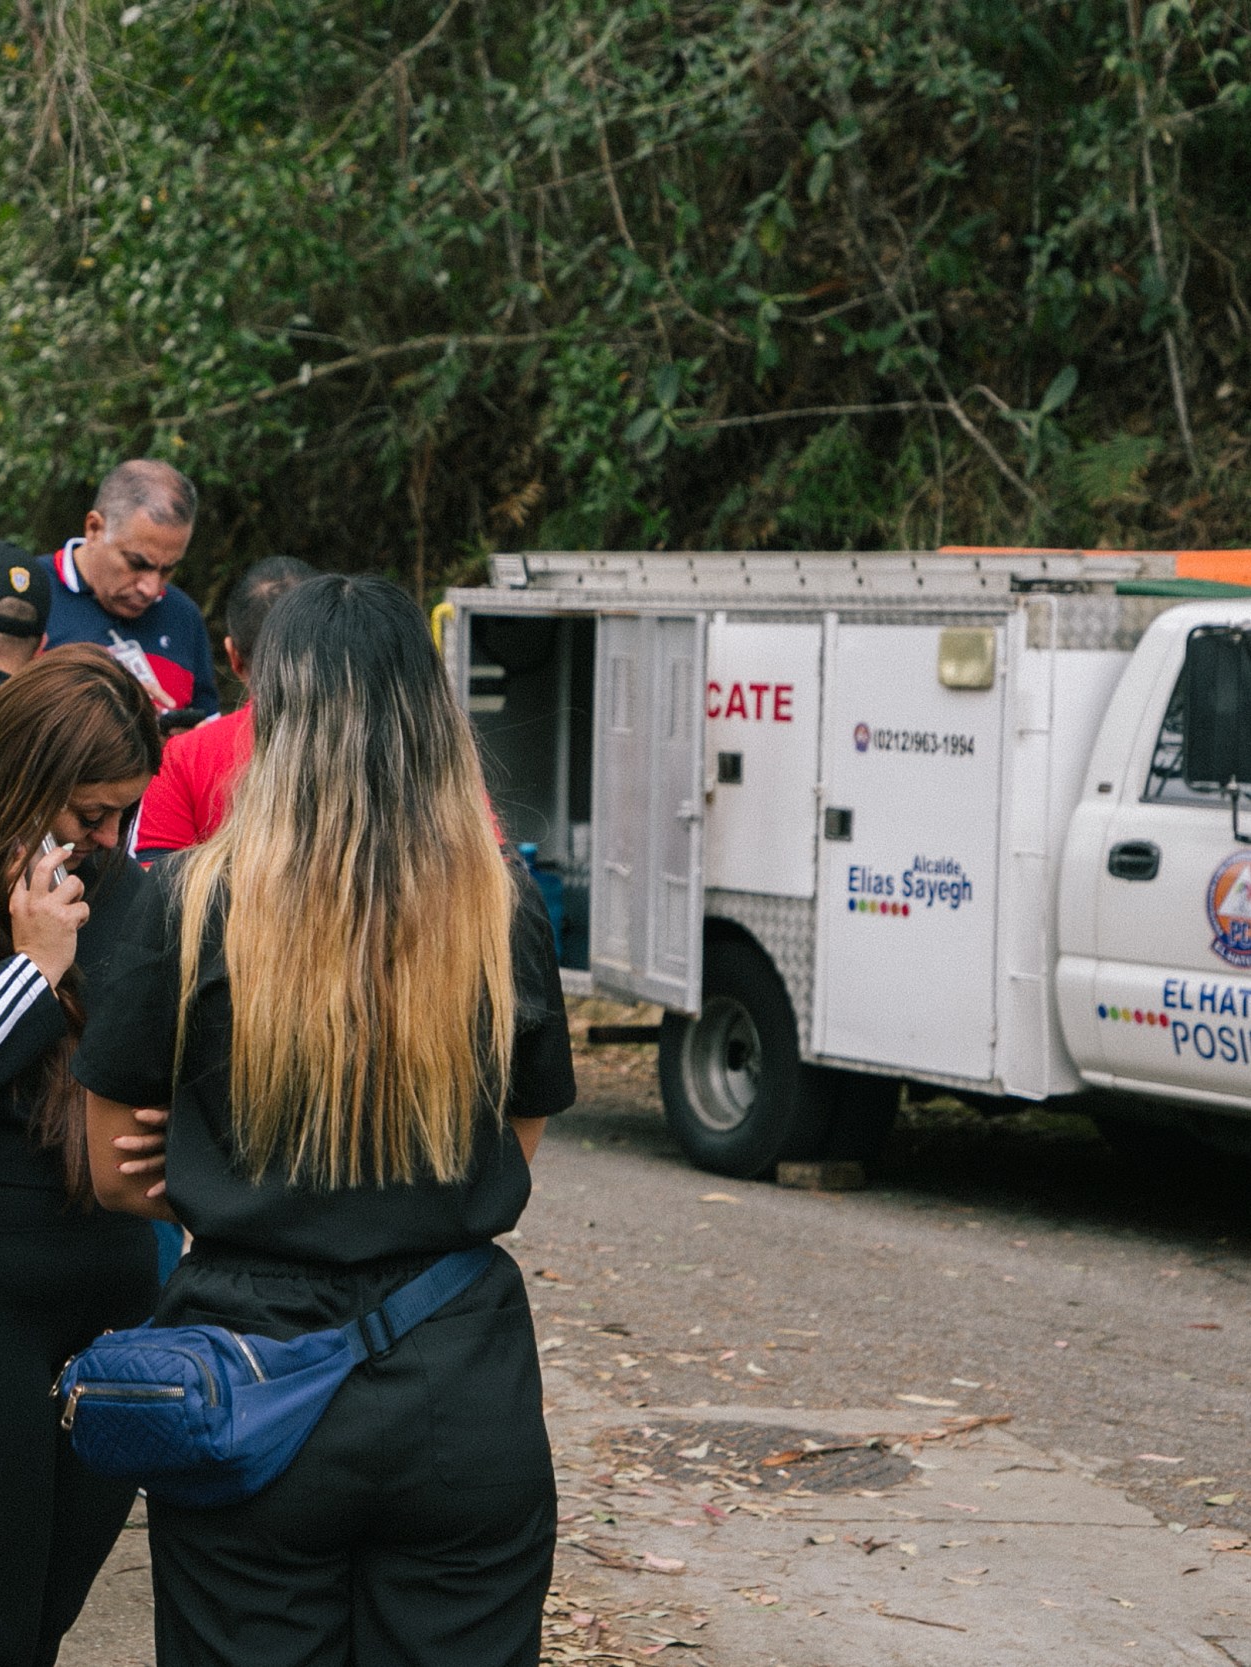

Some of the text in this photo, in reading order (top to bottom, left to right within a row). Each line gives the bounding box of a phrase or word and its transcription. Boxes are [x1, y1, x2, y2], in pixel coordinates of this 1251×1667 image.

[873, 729, 975, 755] (0212)963-1994
[913, 855, 962, 875] Alcalde
[902, 869, 972, 910] Sayegh
[1163, 978, 1192, 1010] EL
[1172, 1020, 1251, 1065] POSI
